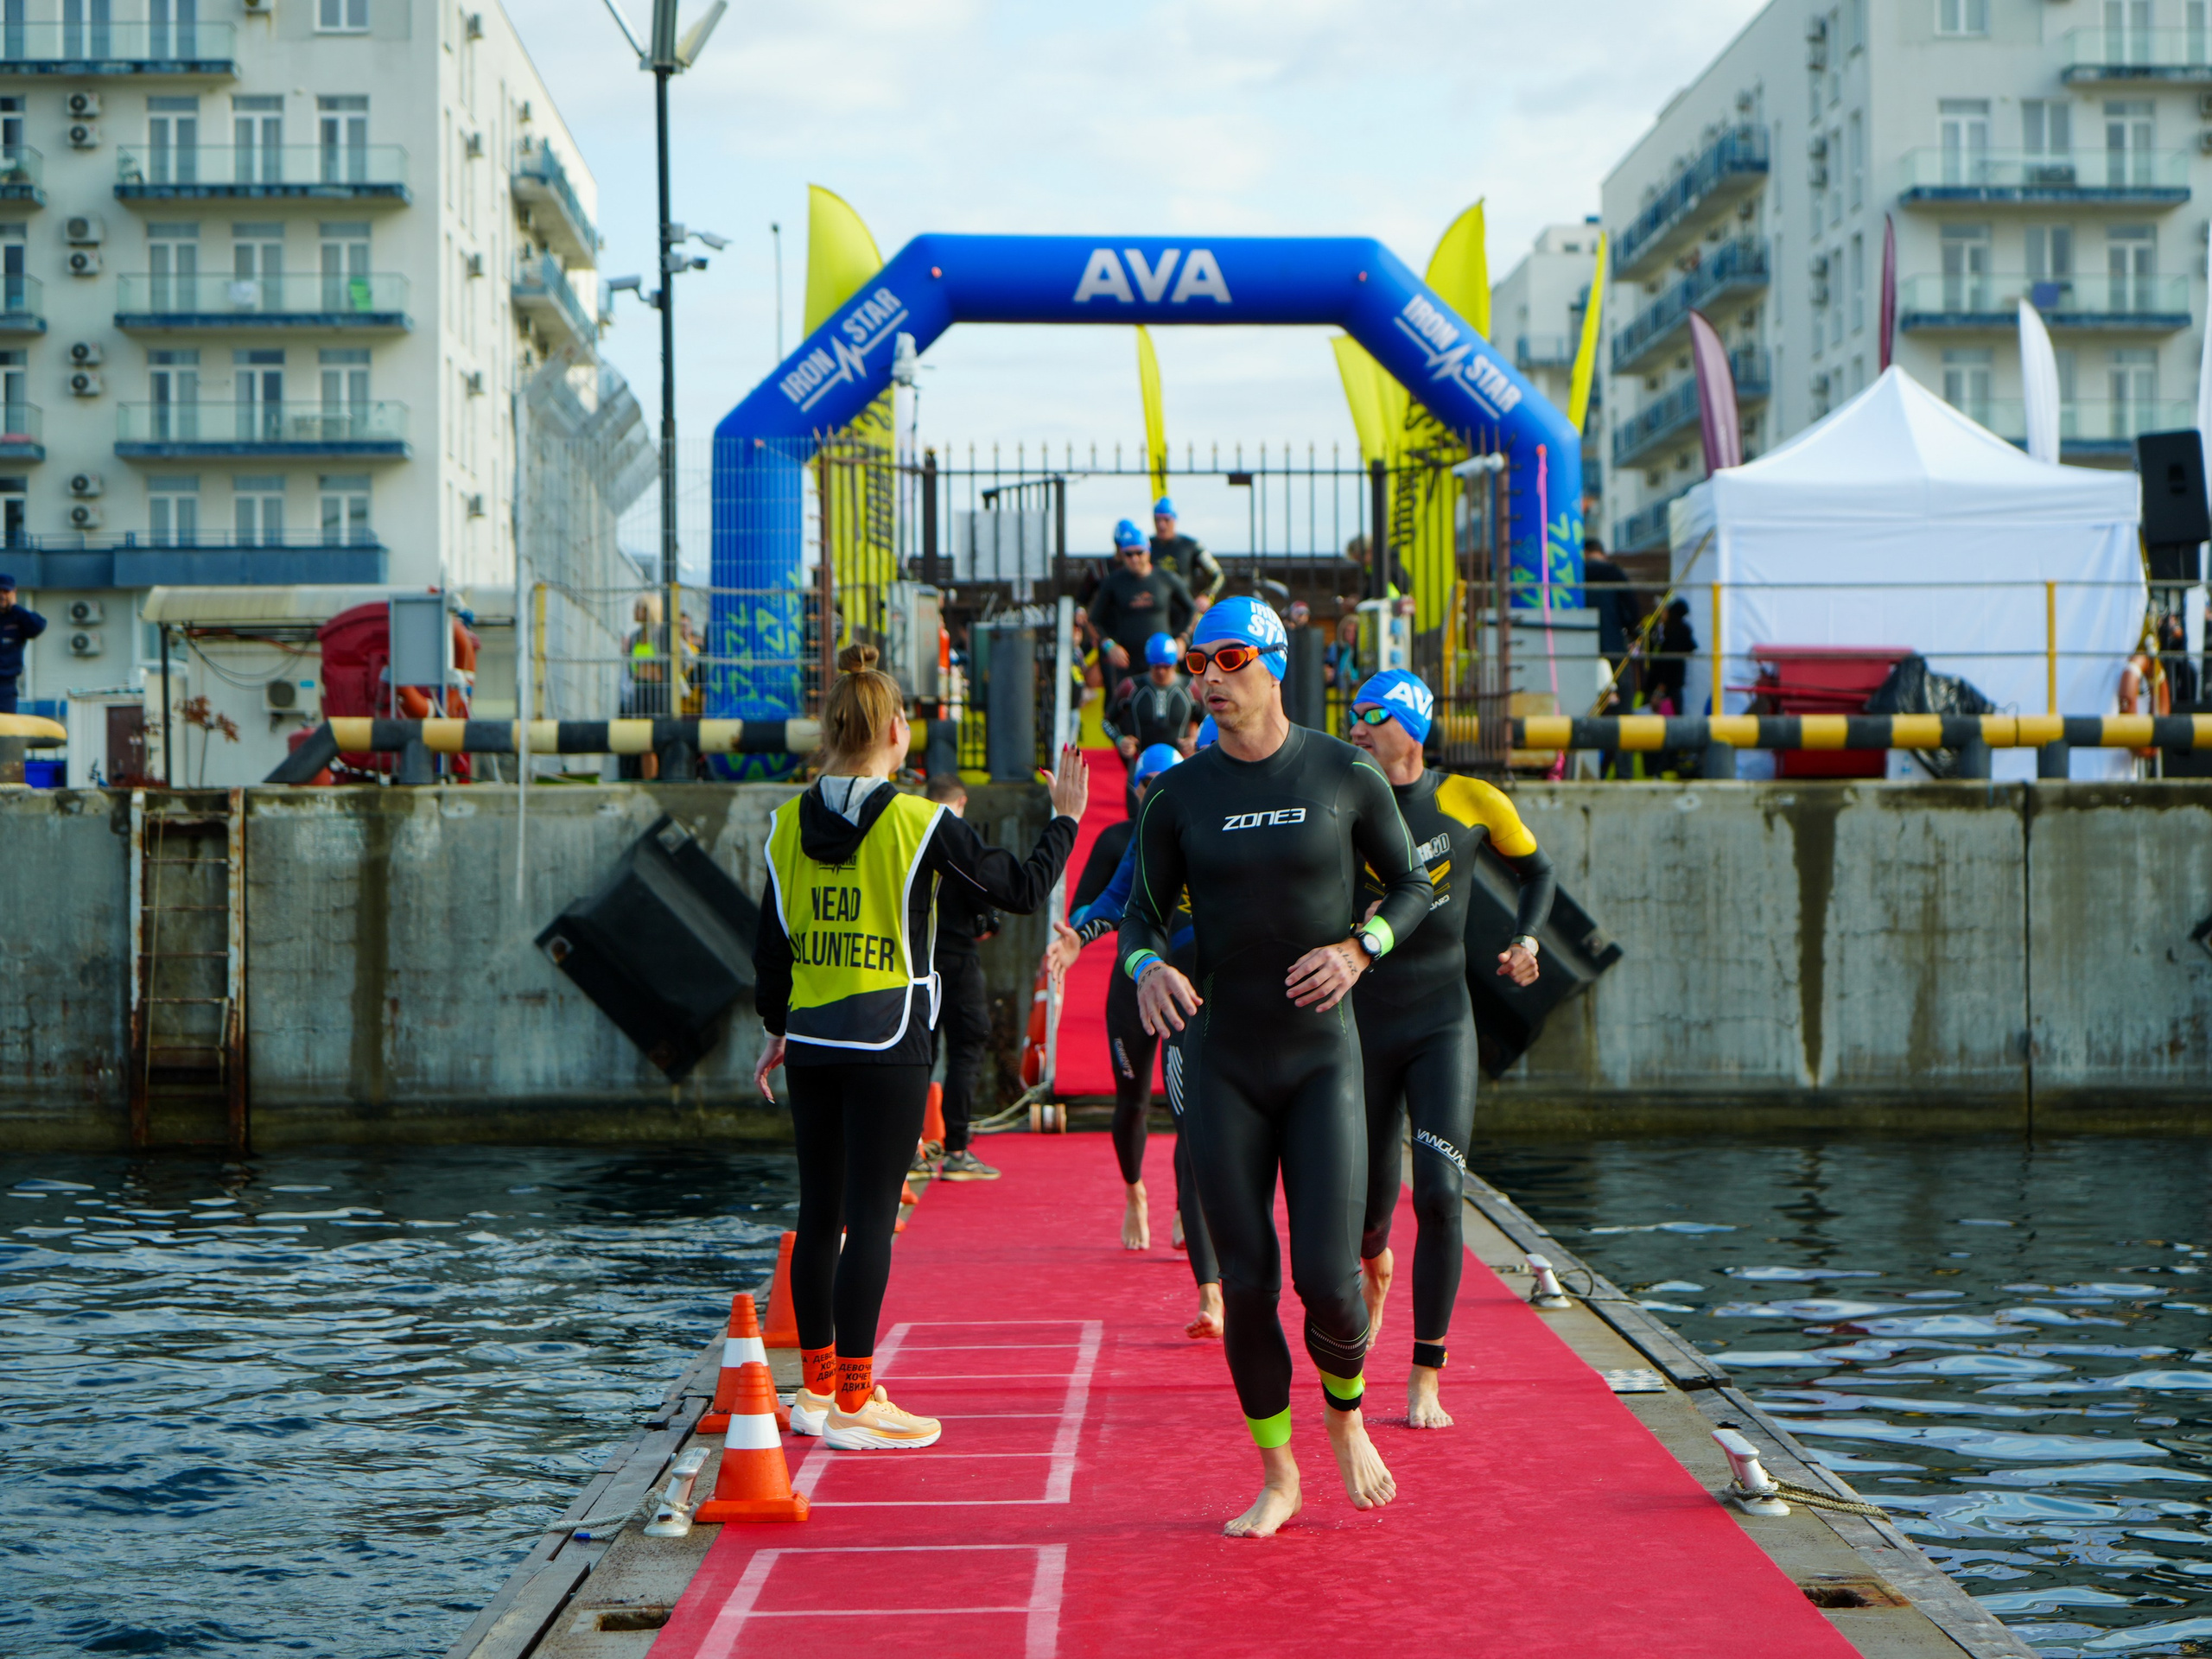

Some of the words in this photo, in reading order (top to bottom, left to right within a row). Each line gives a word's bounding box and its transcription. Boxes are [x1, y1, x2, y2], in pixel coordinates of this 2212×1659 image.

[1073, 247, 1233, 303] AVA
[779, 346, 837, 404] IRON
[842, 287, 902, 343] STAR
[1402, 293, 1460, 351] IRON
[1465, 354, 1522, 413] STAR
[1222, 808, 1306, 830] ZONE3
[841, 1381, 871, 1393] ДВИЖА
